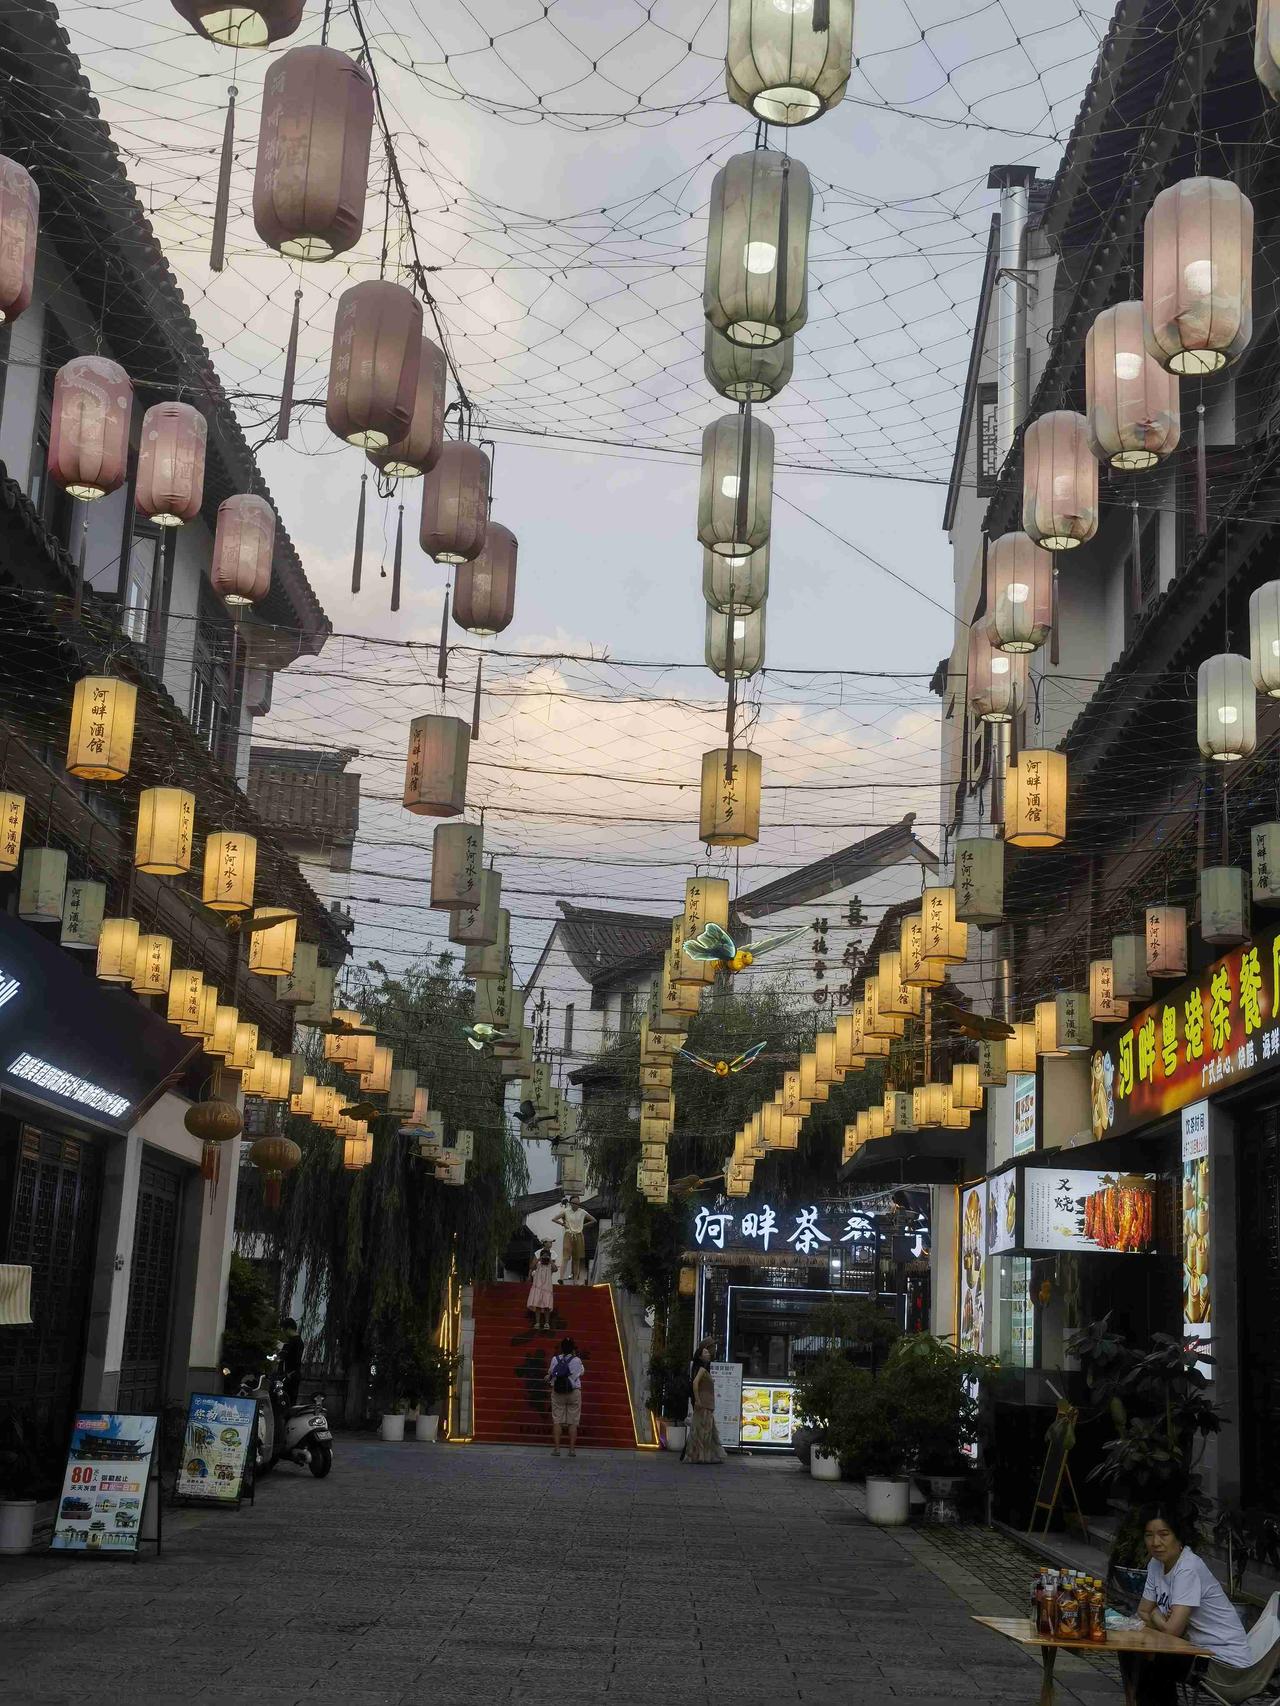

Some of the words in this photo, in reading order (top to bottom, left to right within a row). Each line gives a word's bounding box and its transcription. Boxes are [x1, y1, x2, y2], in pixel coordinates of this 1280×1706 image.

[86, 687, 109, 754] 河畔酒馆
[409, 729, 424, 791] 河畔酒馆
[1026, 760, 1042, 823] 河畔酒馆
[4, 801, 20, 856] 河畔酒馆
[181, 801, 190, 860] 红河水乡
[224, 840, 238, 893] 红河水乡
[465, 835, 478, 891] 红河水乡
[960, 850, 974, 906] 红河水乡
[1257, 834, 1270, 889] 河畔酒馆
[68, 887, 82, 933] 河畔酒馆
[689, 886, 701, 938] 红河水乡
[930, 897, 944, 949] 红河水乡
[151, 941, 162, 985] 河畔酒馆
[910, 924, 923, 973] 红河水乡
[1149, 914, 1161, 963] 红河水乡
[188, 975, 199, 1016] 河畔酒馆
[1100, 965, 1111, 1010] 河畔酒馆
[1065, 997, 1077, 1038] 河畔酒馆
[72, 1466, 93, 1484] 80
